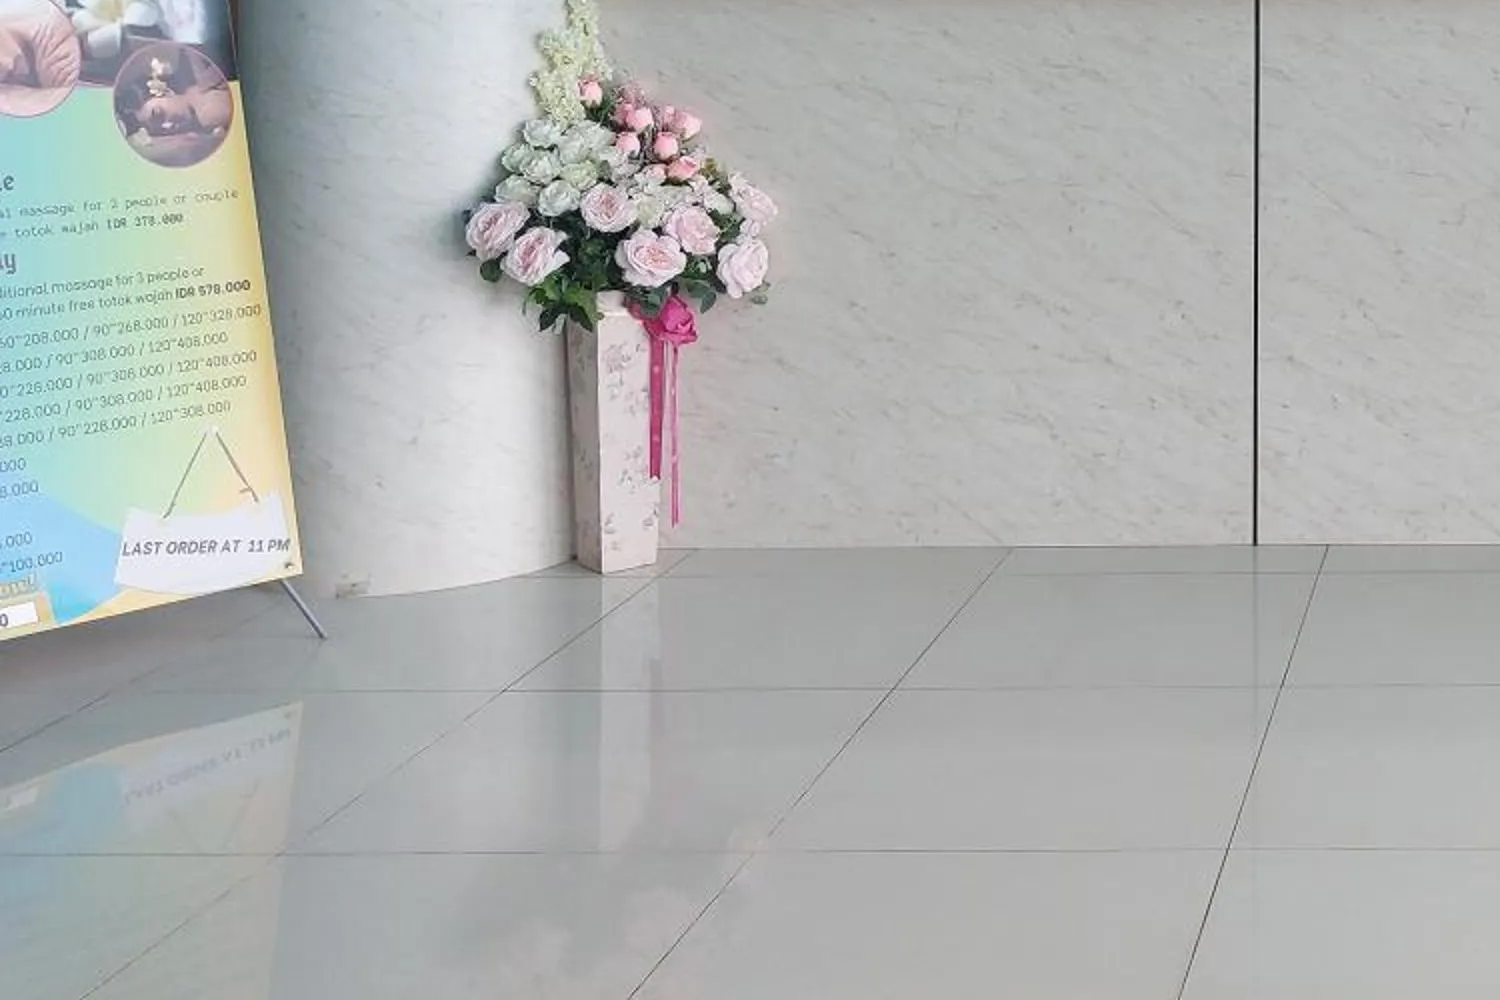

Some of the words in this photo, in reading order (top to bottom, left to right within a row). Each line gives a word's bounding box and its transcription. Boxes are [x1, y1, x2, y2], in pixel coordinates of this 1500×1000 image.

[121, 540, 163, 557] LAST
[165, 539, 218, 555] ORDER
[220, 539, 241, 553] AT
[247, 539, 263, 553] 11
[267, 537, 291, 552] PM
